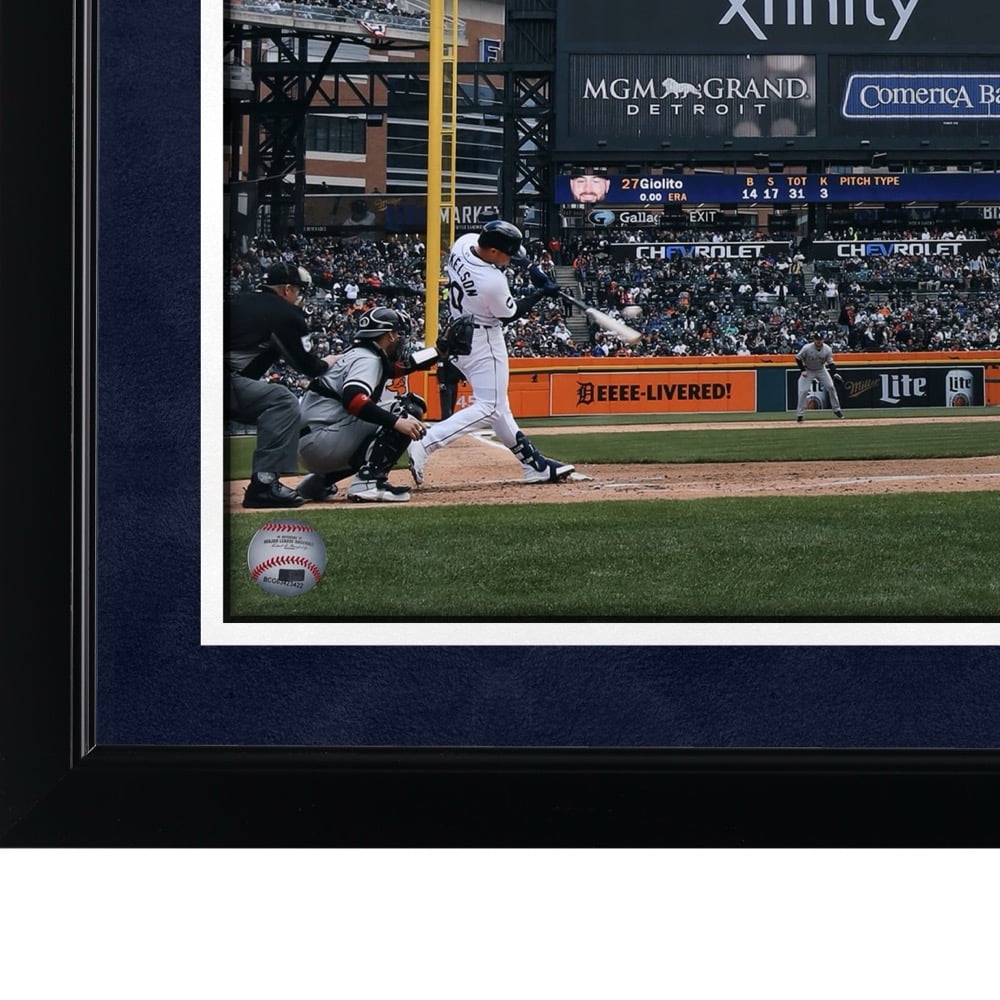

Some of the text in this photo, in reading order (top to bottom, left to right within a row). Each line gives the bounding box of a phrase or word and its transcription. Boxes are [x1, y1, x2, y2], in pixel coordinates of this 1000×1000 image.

[583, 77, 806, 100] MGM GRAND
[626, 104, 767, 116] DETROIT
[621, 178, 638, 190] 27
[640, 178, 683, 190] Giolito
[787, 177, 807, 186] TOT
[840, 176, 871, 186] PITCH
[875, 176, 900, 186] TYPE
[640, 188, 805, 202] 0.00 ERA 14 17 31
[690, 211, 716, 223] EXIT
[837, 242, 962, 257] CHEVROLET
[846, 374, 927, 404] Miller Lite
[949, 376, 972, 393] Lite
